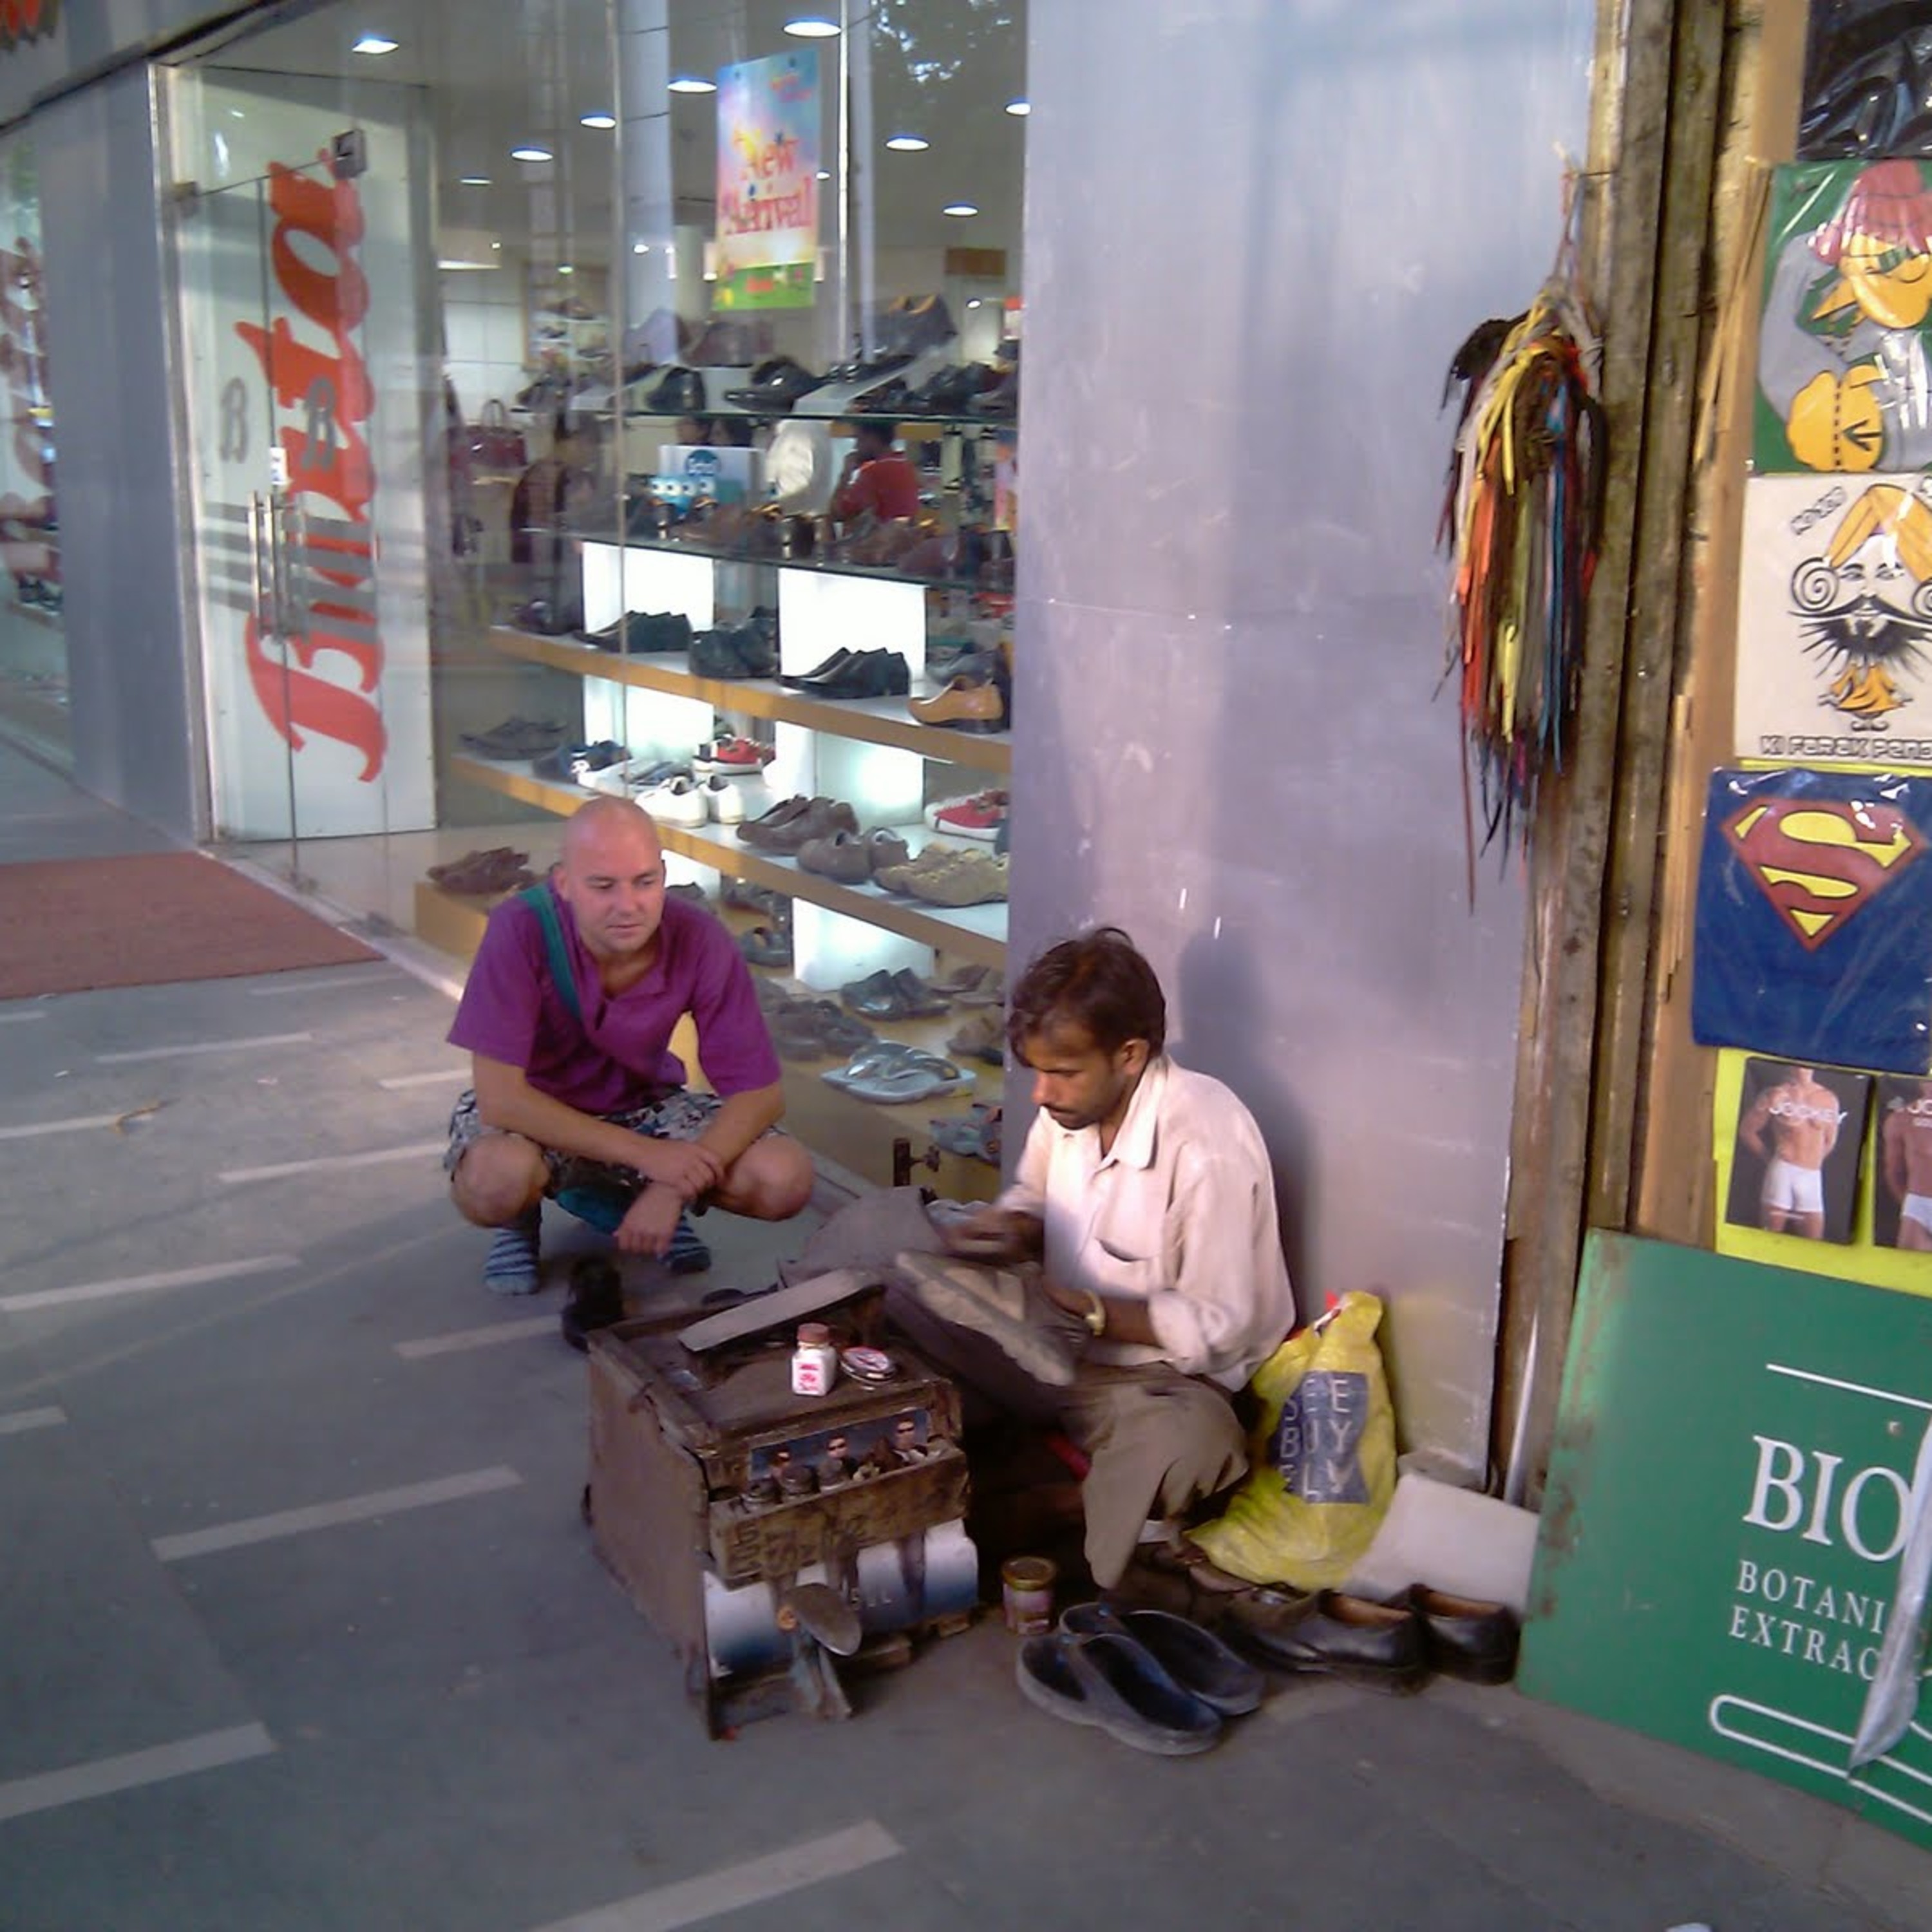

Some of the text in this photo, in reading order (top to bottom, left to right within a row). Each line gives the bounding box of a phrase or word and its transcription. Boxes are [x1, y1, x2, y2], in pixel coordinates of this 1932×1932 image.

[234, 148, 388, 782] Bata
[1280, 1418, 1352, 1458] BUY
[1742, 1434, 1914, 1562] BIO
[1736, 1559, 1886, 1635] BOTANI
[1728, 1605, 1883, 1681] EXTRAC
